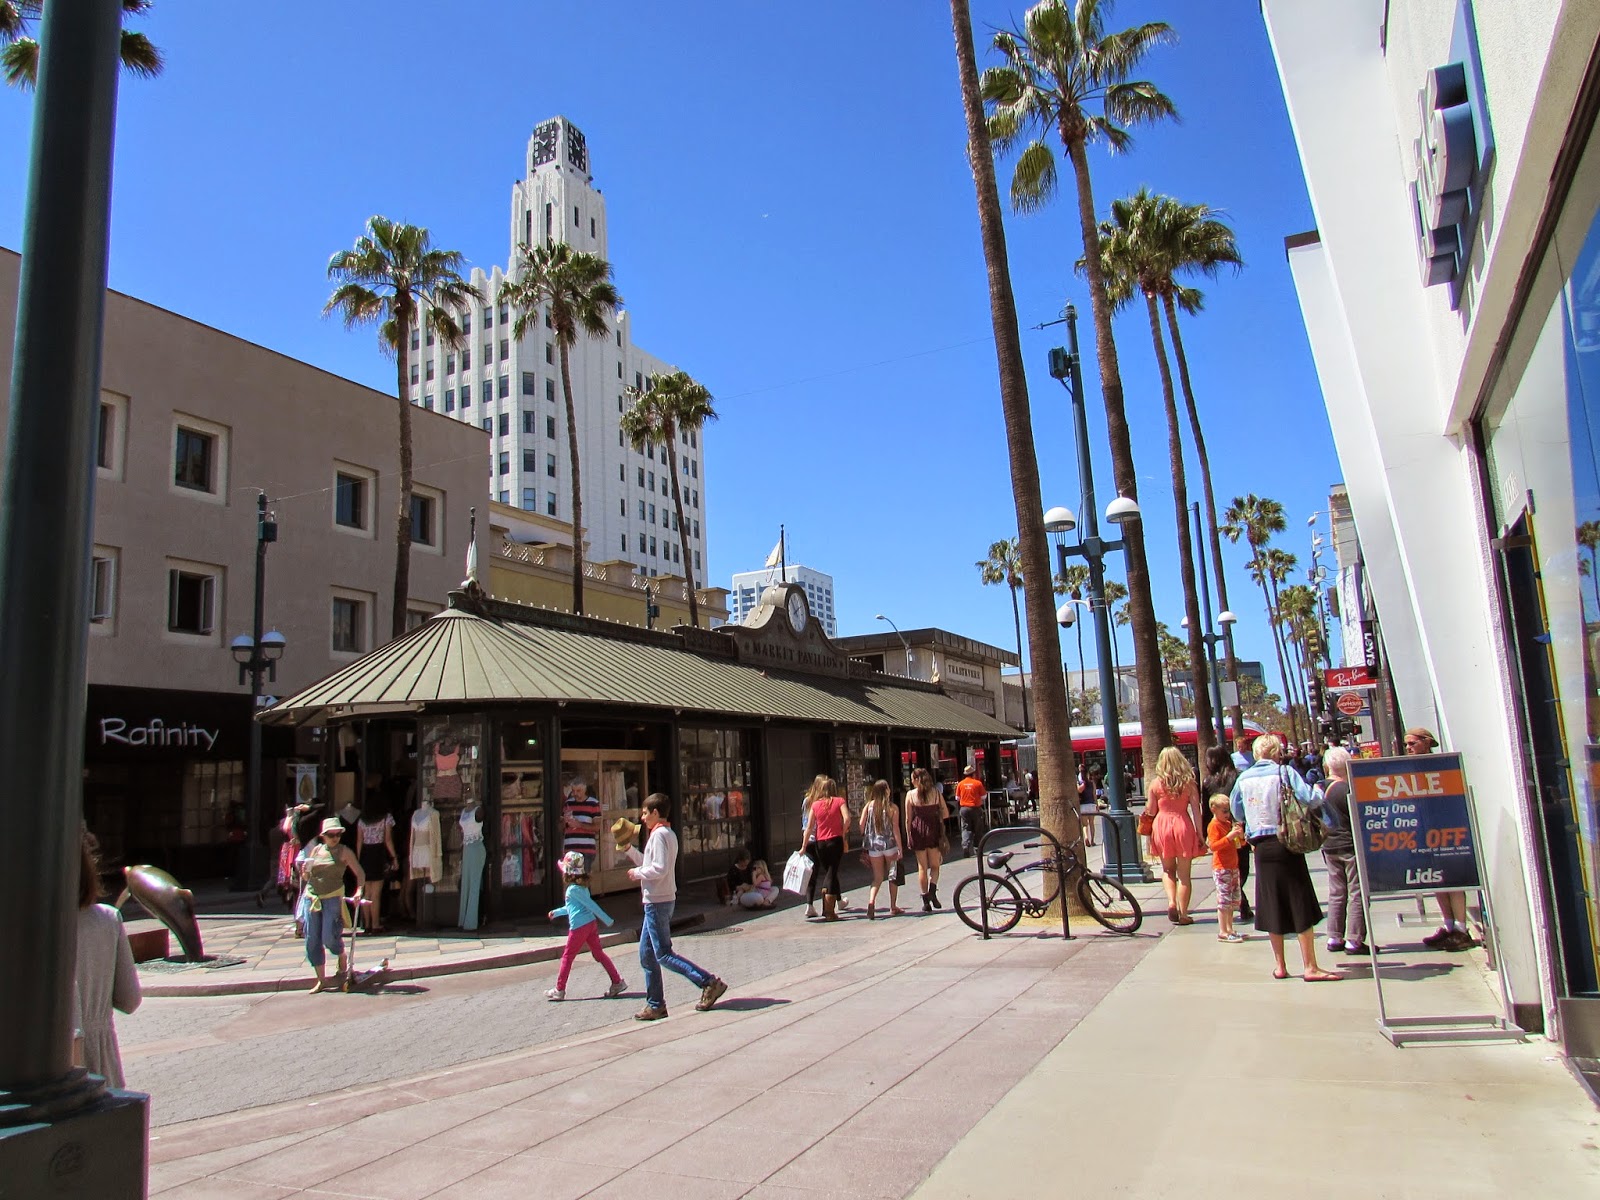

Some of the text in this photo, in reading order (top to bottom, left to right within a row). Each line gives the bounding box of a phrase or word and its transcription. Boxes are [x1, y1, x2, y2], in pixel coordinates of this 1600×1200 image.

[752, 641, 838, 669] MARKET PAVILION
[1332, 668, 1367, 686] Ray-Ban
[100, 717, 220, 751] Rafinity
[1375, 772, 1444, 798] SALE
[1364, 803, 1416, 818] Buy One
[1365, 817, 1418, 830] Get One
[1370, 827, 1468, 852] 50% OFF
[1405, 867, 1444, 884] Lids
